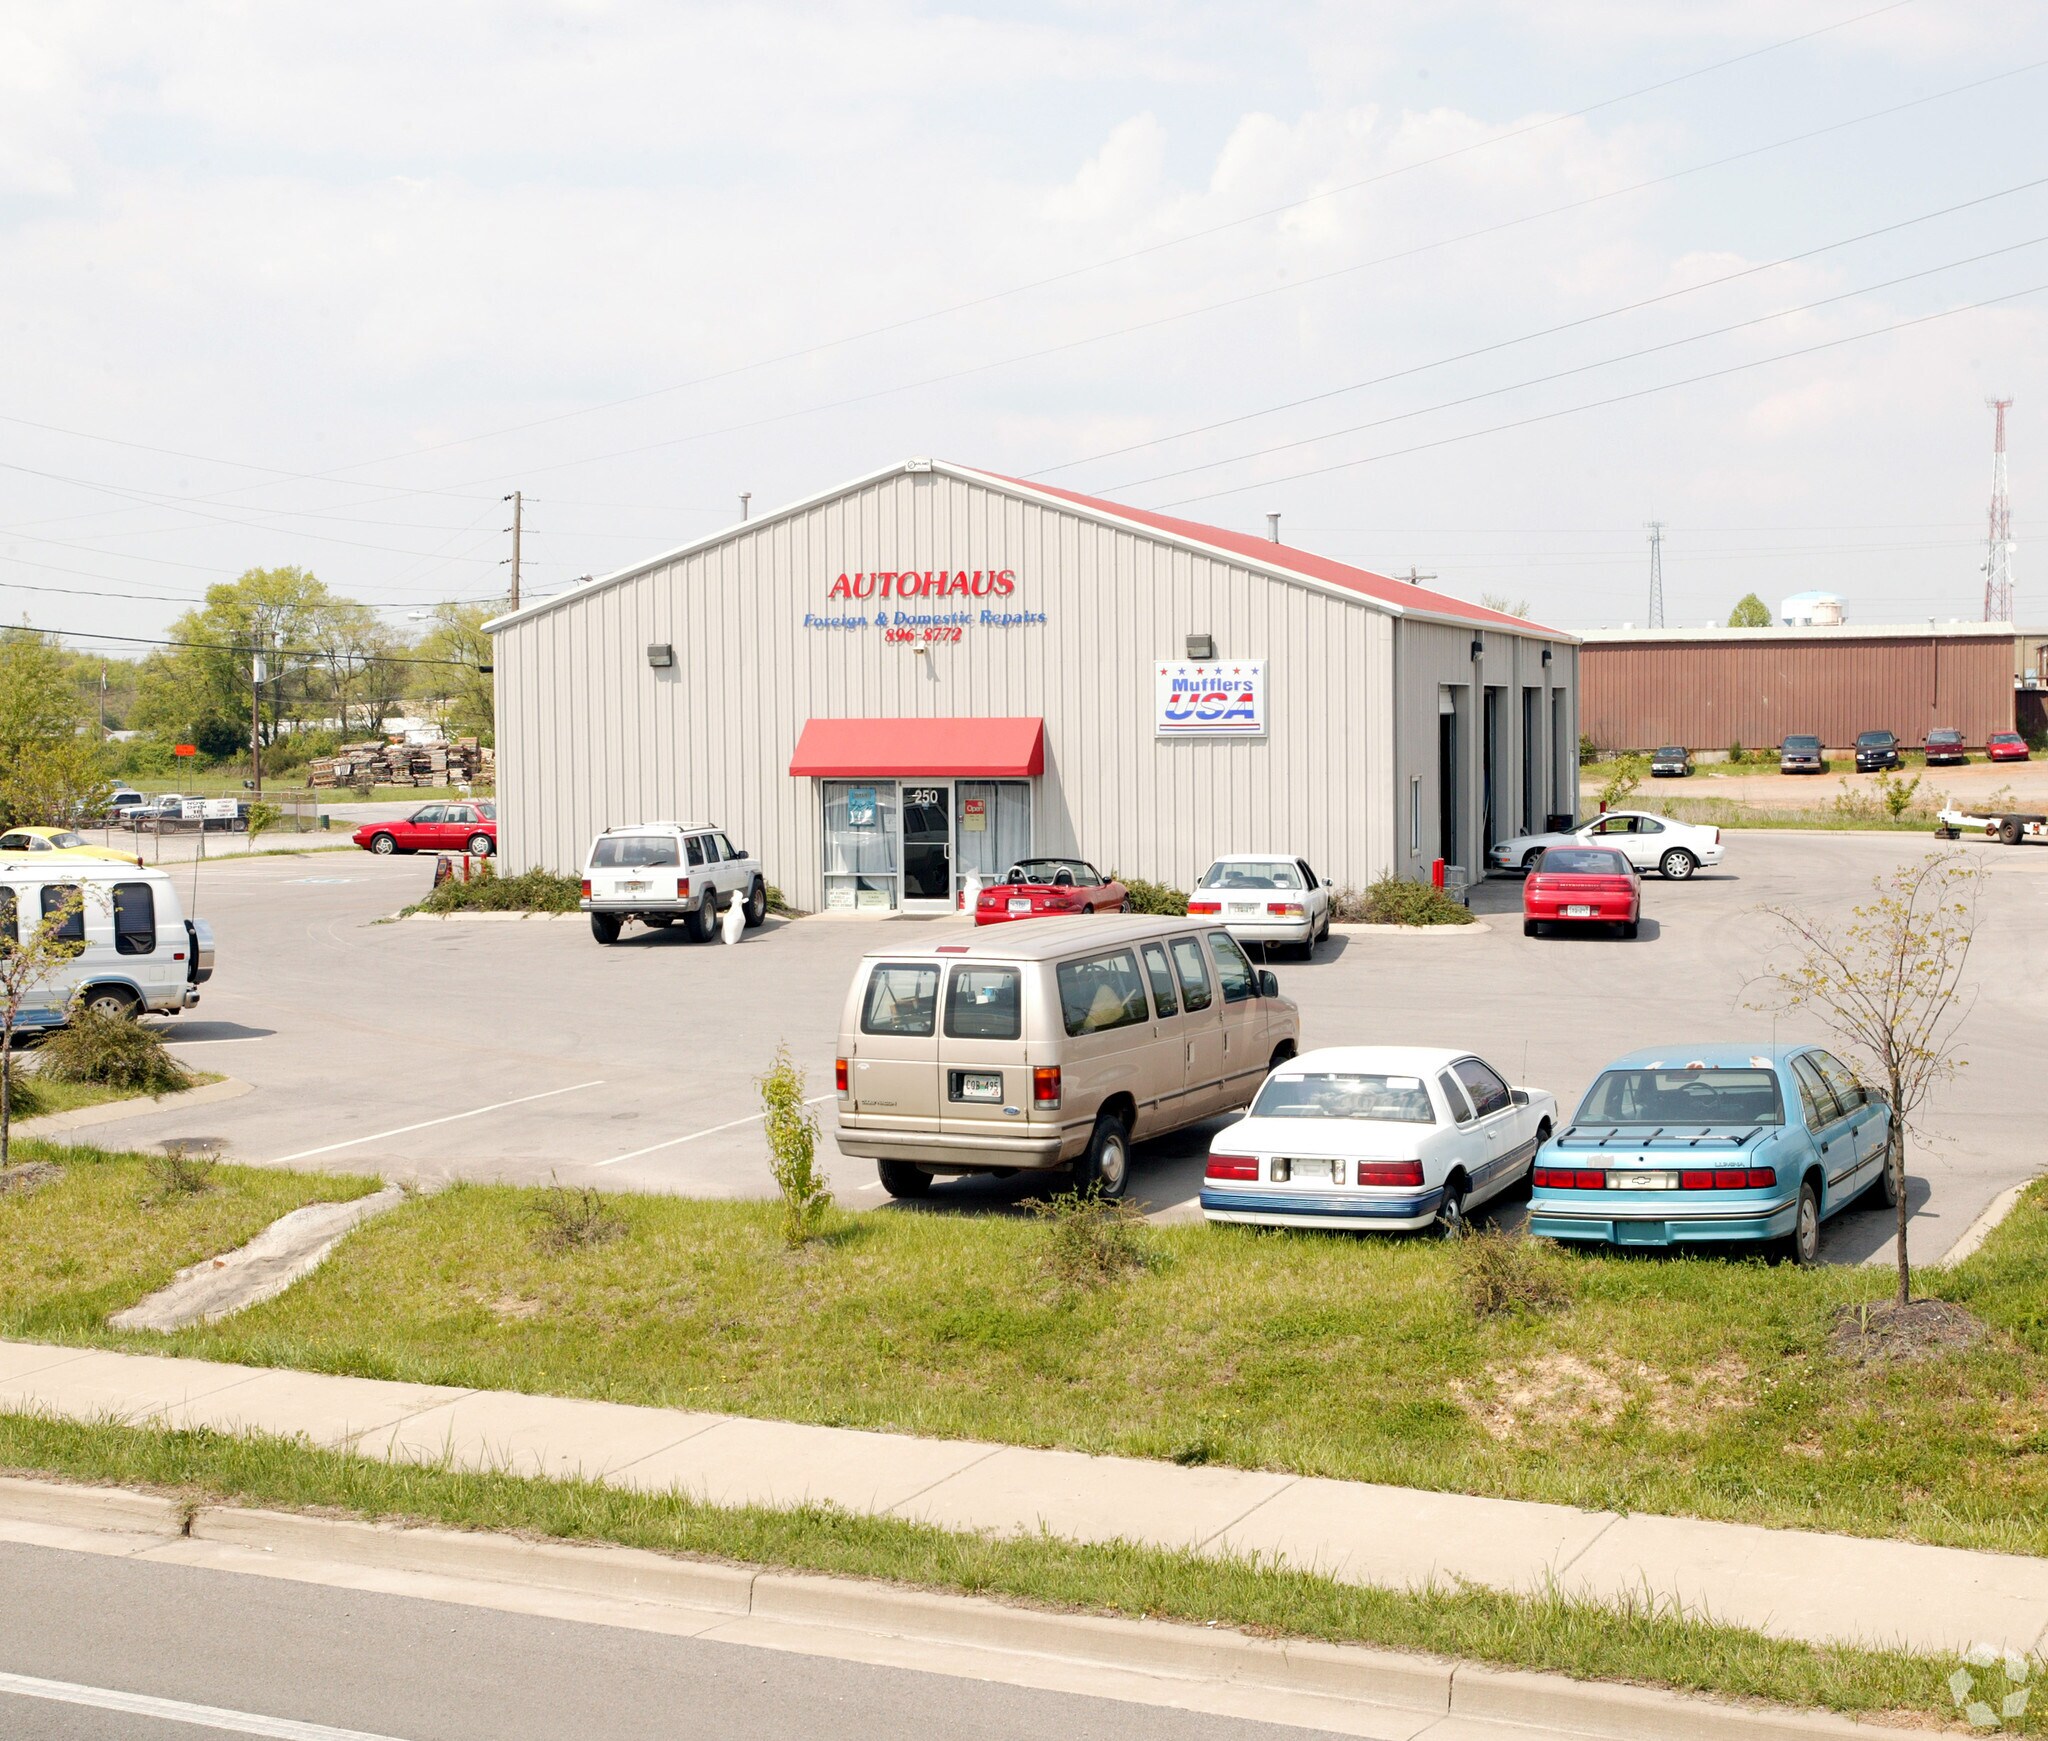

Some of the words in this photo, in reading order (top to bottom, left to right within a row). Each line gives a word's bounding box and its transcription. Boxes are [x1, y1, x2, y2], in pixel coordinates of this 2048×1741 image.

[828, 570, 1015, 598] AUTOHAUS
[803, 613, 867, 629] Foreign
[875, 611, 888, 626] &
[893, 610, 972, 626] Domestic
[979, 609, 1047, 626] Repairs
[884, 627, 962, 642] 896-8772
[1172, 678, 1253, 692] Mufflers
[1165, 692, 1255, 720] USA
[914, 789, 938, 804] 250
[966, 805, 984, 813] Open
